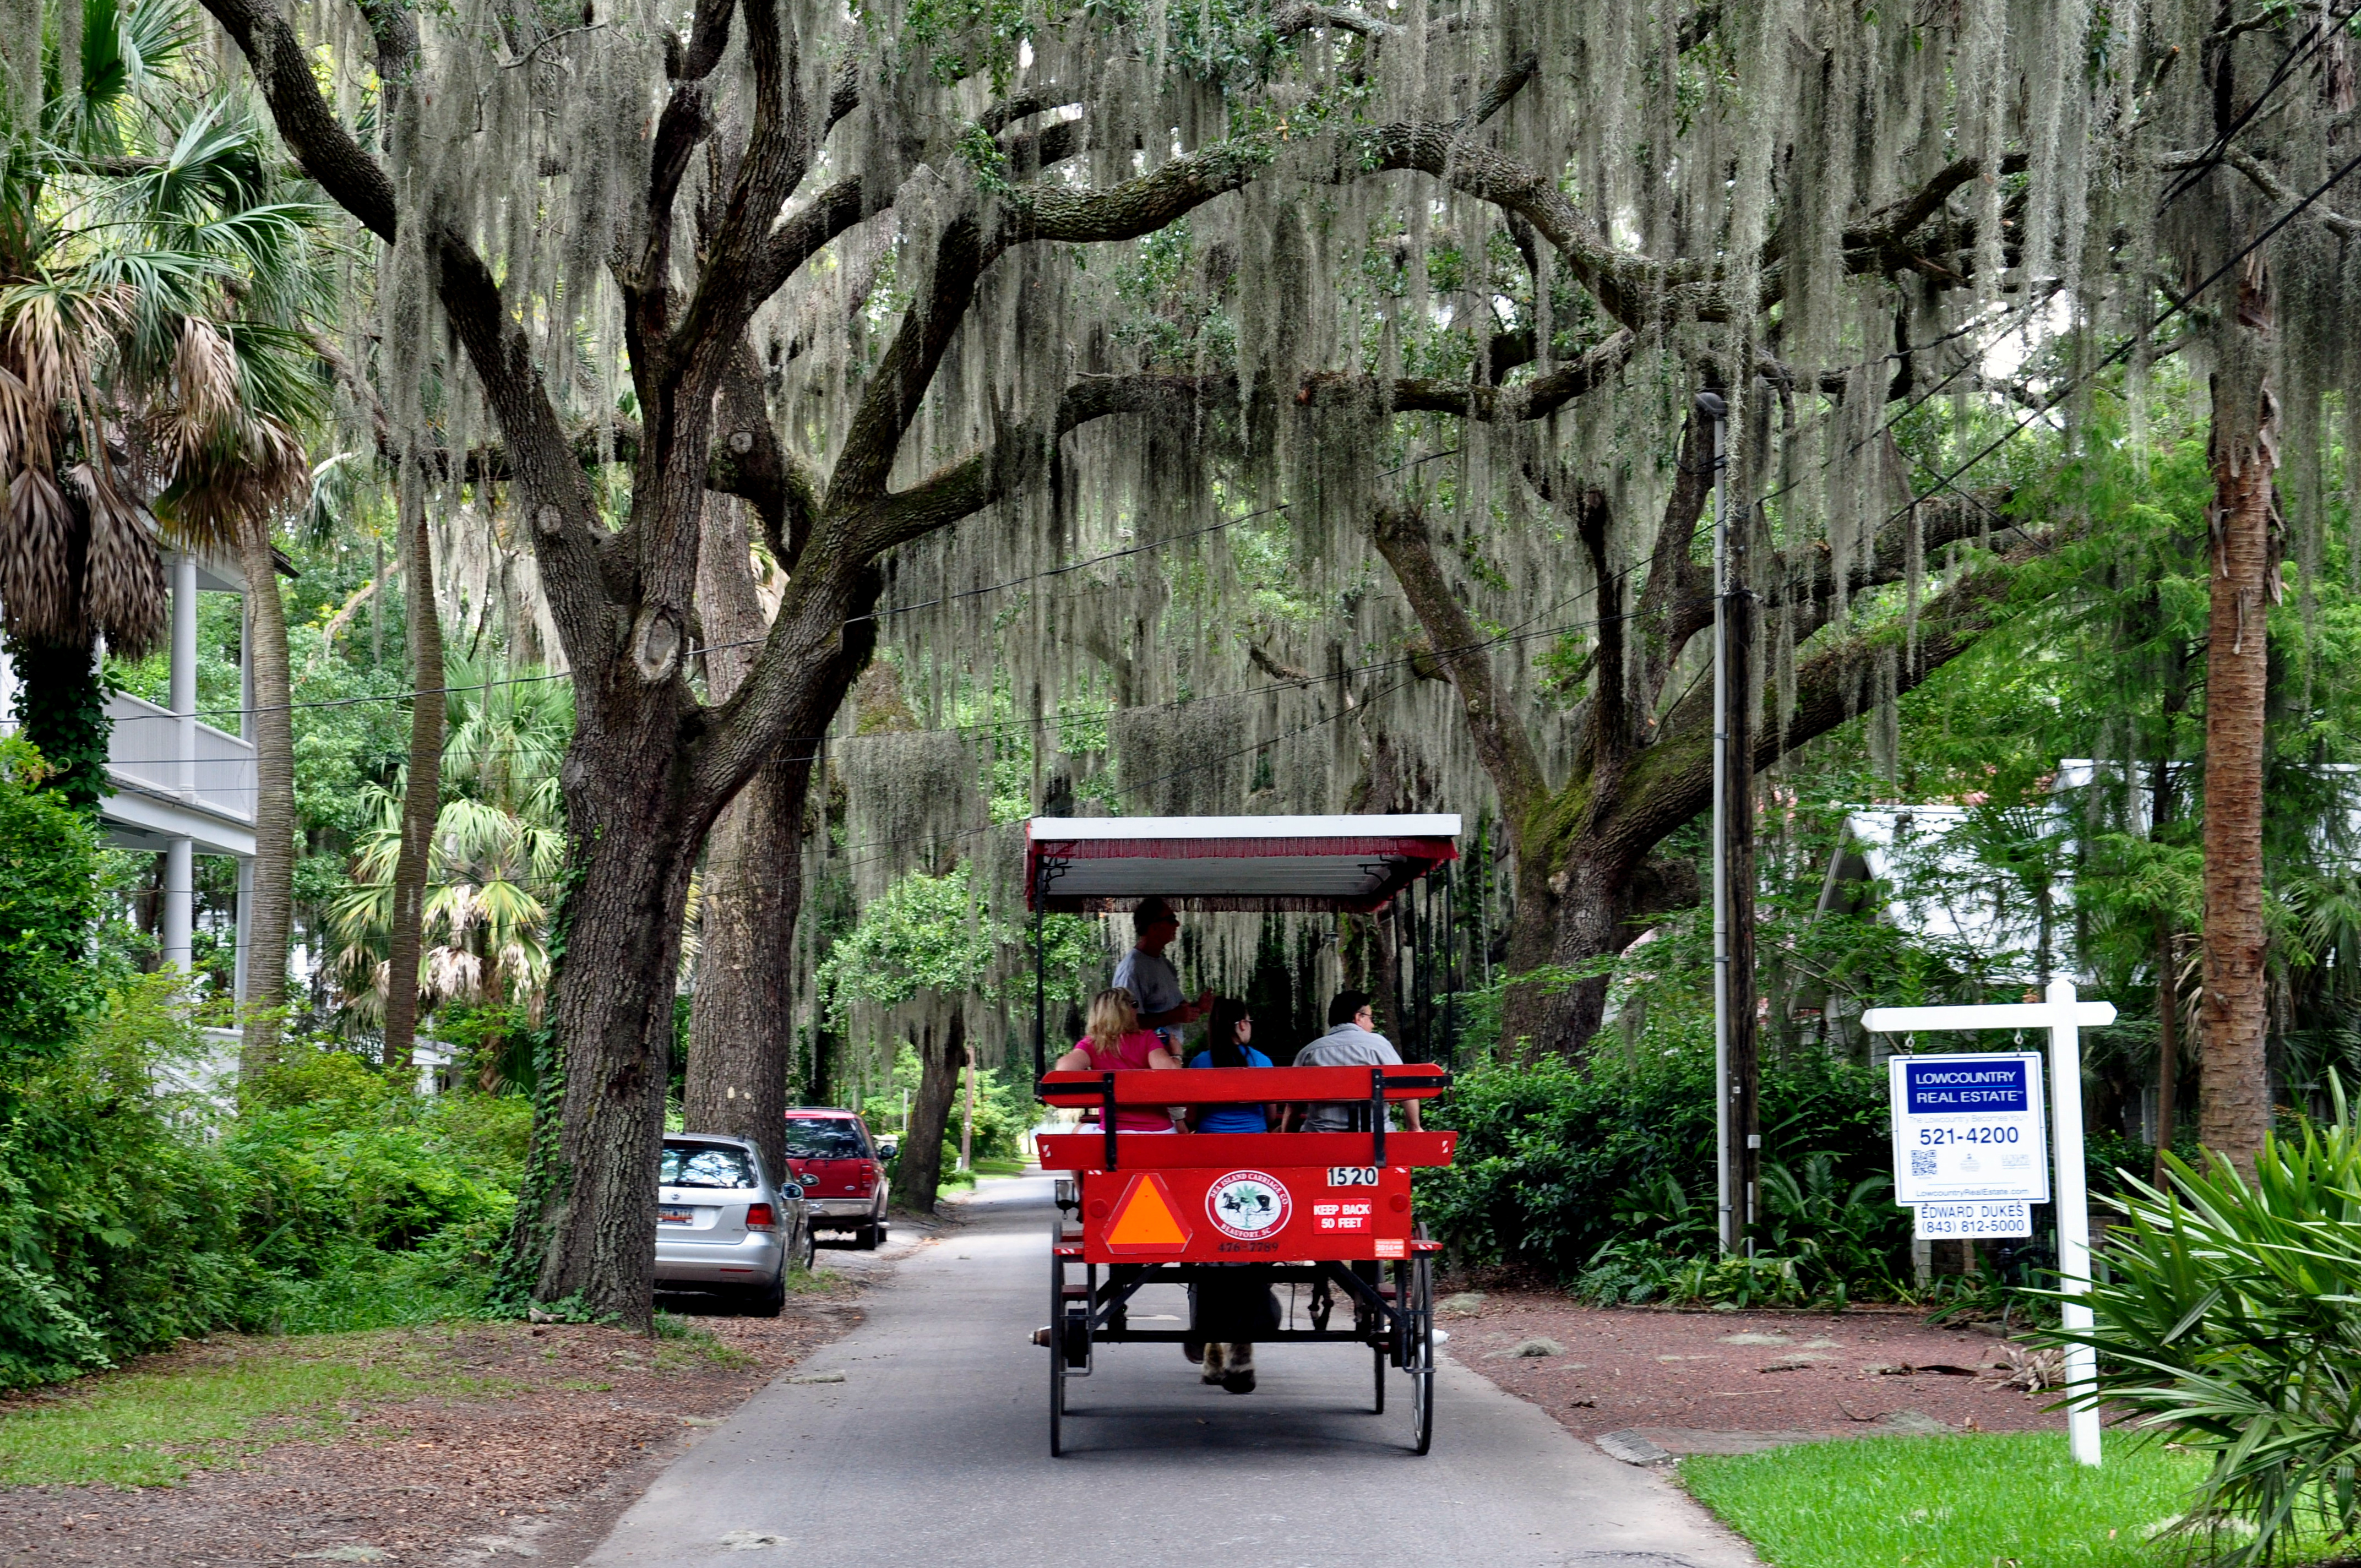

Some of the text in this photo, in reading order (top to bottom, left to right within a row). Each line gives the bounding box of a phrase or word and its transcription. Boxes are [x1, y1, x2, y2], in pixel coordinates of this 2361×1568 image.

[1916, 1071, 2016, 1084] LOWCOUNTRY
[1917, 1092, 1959, 1103] REAL
[1920, 1126, 2019, 1145] 521-4200
[1327, 1167, 1376, 1185] 1520
[1210, 1185, 1222, 1198] SEA
[1221, 1173, 1247, 1186] ISLAND
[1248, 1173, 1282, 1194] CARRIAGE
[1916, 1189, 2030, 1197] LowcountryRealEstate.com
[1314, 1204, 1370, 1215] KEEP BACK
[1922, 1205, 2024, 1218] EDWARD DUKES
[1321, 1217, 1363, 1228] 50 FEET
[1922, 1219, 2025, 1233] (843) 812-5000
[1218, 1242, 1279, 1252] 476-7789
